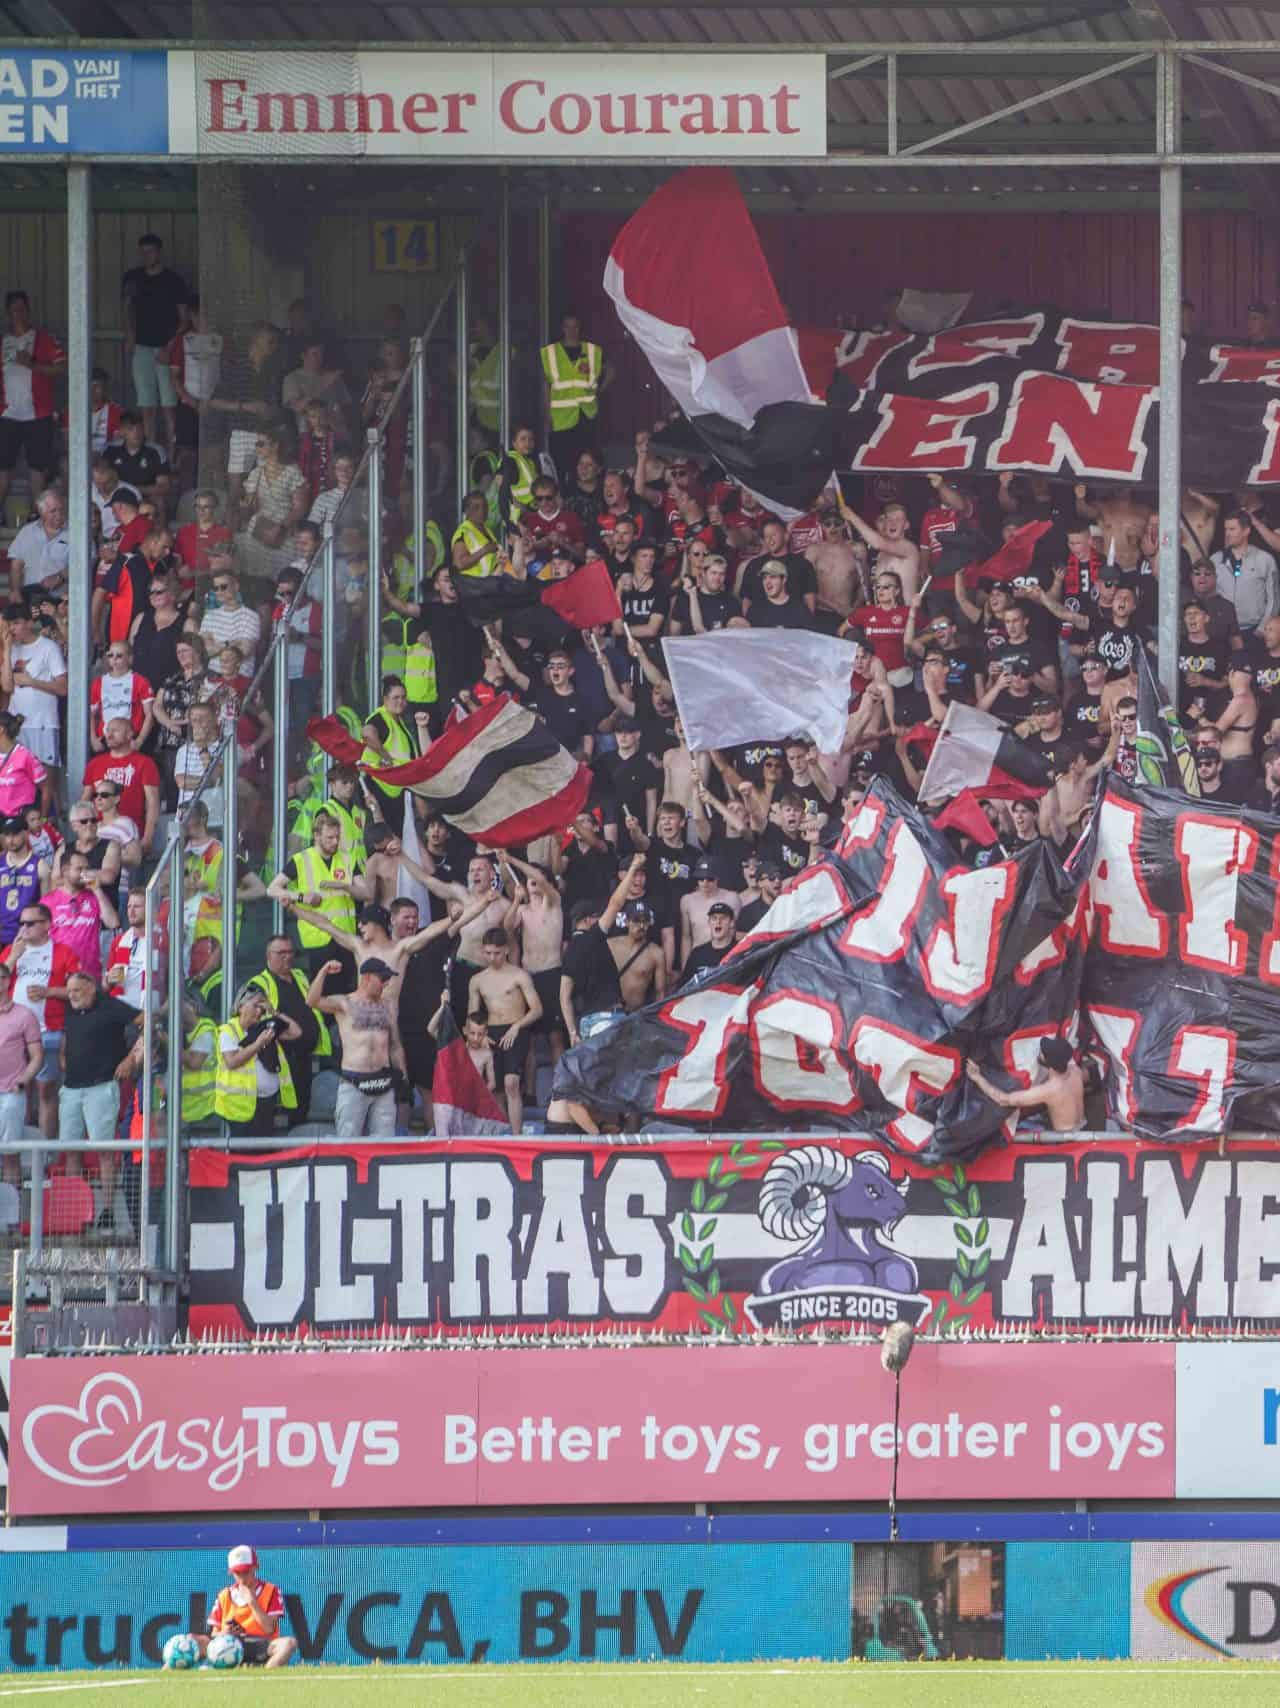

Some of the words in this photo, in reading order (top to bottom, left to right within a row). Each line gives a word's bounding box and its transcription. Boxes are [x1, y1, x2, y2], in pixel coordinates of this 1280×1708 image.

[203, 78, 477, 135] Emmer
[498, 78, 801, 136] Courant
[379, 222, 429, 265] 14
[851, 368, 1161, 482] EN
[236, 1153, 668, 1326] ULTRAS
[780, 1295, 841, 1322] SINCE
[845, 1297, 898, 1321] 2005
[444, 1414, 622, 1465] Better
[641, 1415, 782, 1473] toys,
[803, 1411, 1028, 1473] greater
[1049, 1404, 1165, 1471] joys
[283, 1590, 490, 1664] VCA,
[518, 1589, 704, 1658] BHV
